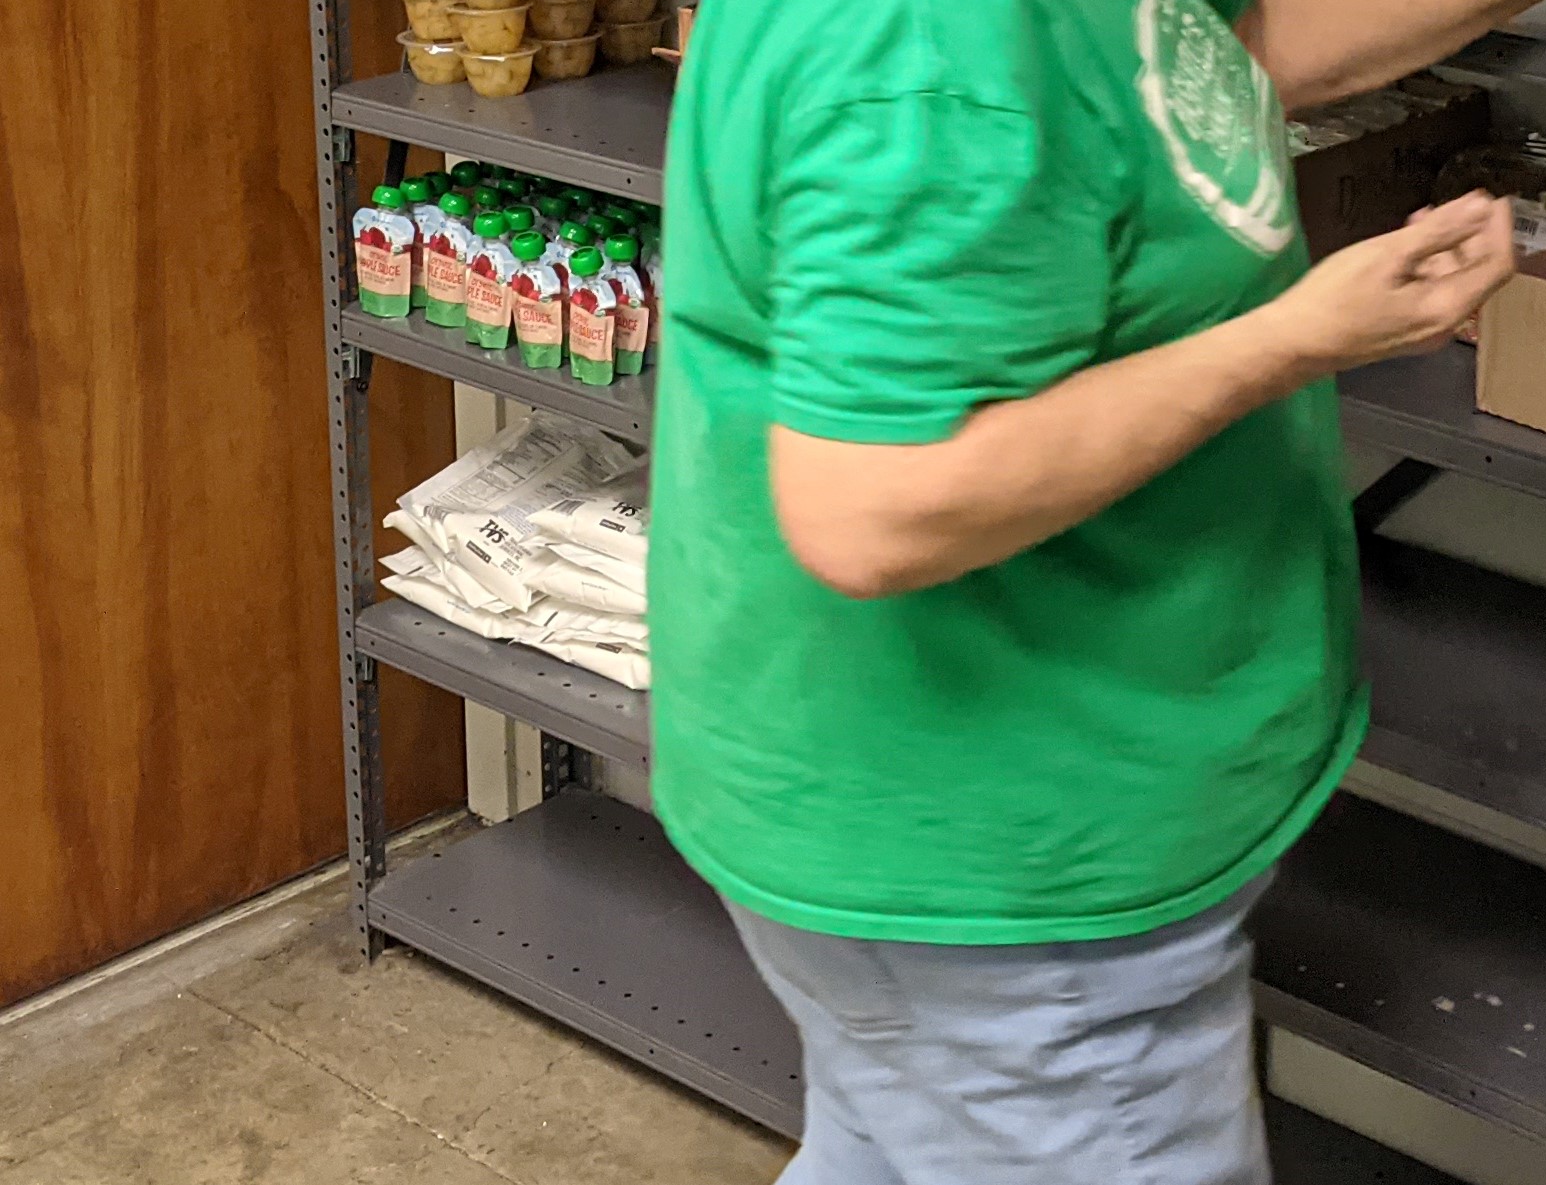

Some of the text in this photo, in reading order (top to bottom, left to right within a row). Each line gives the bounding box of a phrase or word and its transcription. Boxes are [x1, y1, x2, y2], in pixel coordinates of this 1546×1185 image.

[376, 262, 401, 276] SAUCE
[438, 267, 463, 285] SAUCE
[480, 290, 503, 307] SAUCE
[522, 309, 553, 324] SAUCE
